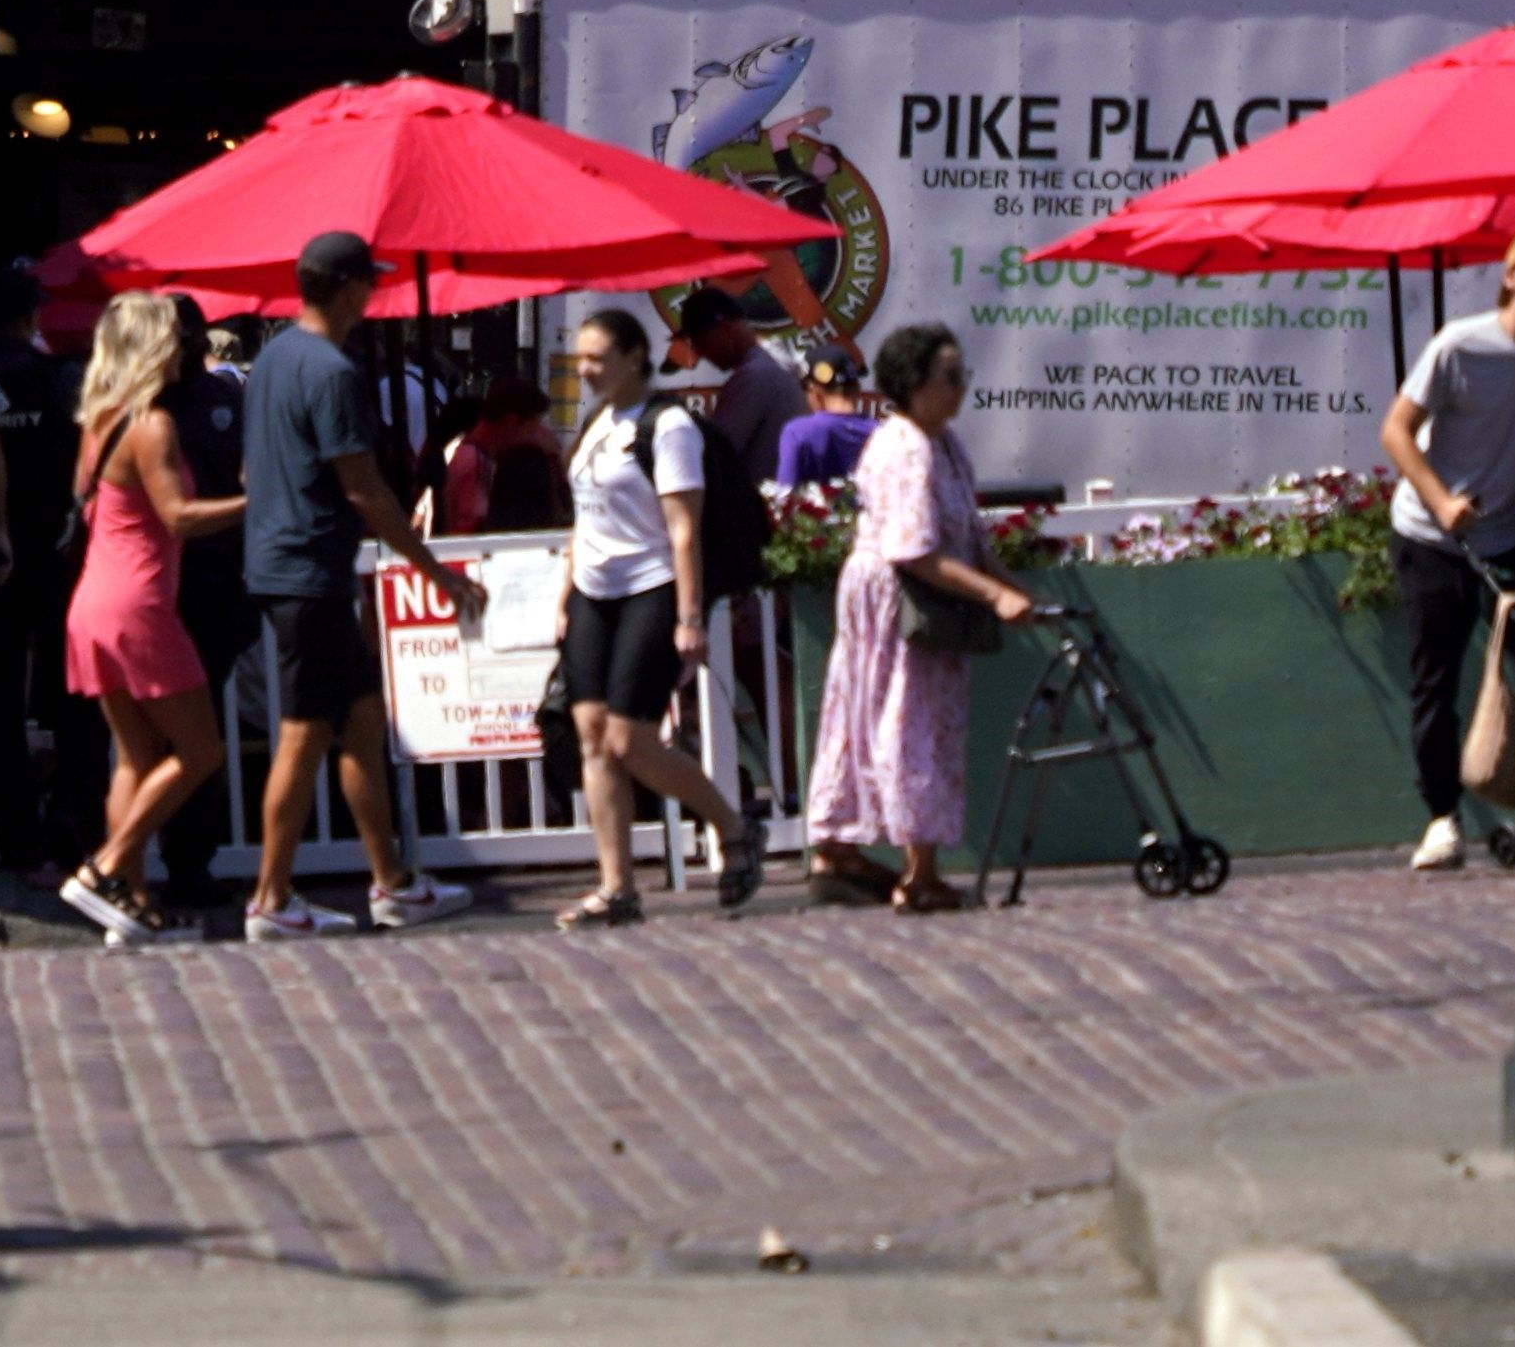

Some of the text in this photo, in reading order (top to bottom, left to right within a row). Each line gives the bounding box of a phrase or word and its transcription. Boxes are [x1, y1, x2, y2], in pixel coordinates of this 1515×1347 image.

[898, 94, 1062, 161] PIKE
[922, 168, 1009, 189] UNDER
[1017, 169, 1064, 190] THE
[1073, 170, 1155, 190] CLOCK
[994, 195, 1023, 217] 86
[1033, 195, 1086, 217] PIKE
[834, 188, 882, 322] MARKET
[971, 303, 1369, 334] www.pikeplacefish.com
[1045, 365, 1302, 387] WE PACK TO TRAVEL
[973, 387, 1372, 415] SHIPPING ANYWHERE IN THE U.S.
[398, 638, 460, 659] FROM
[419, 673, 447, 695] TO
